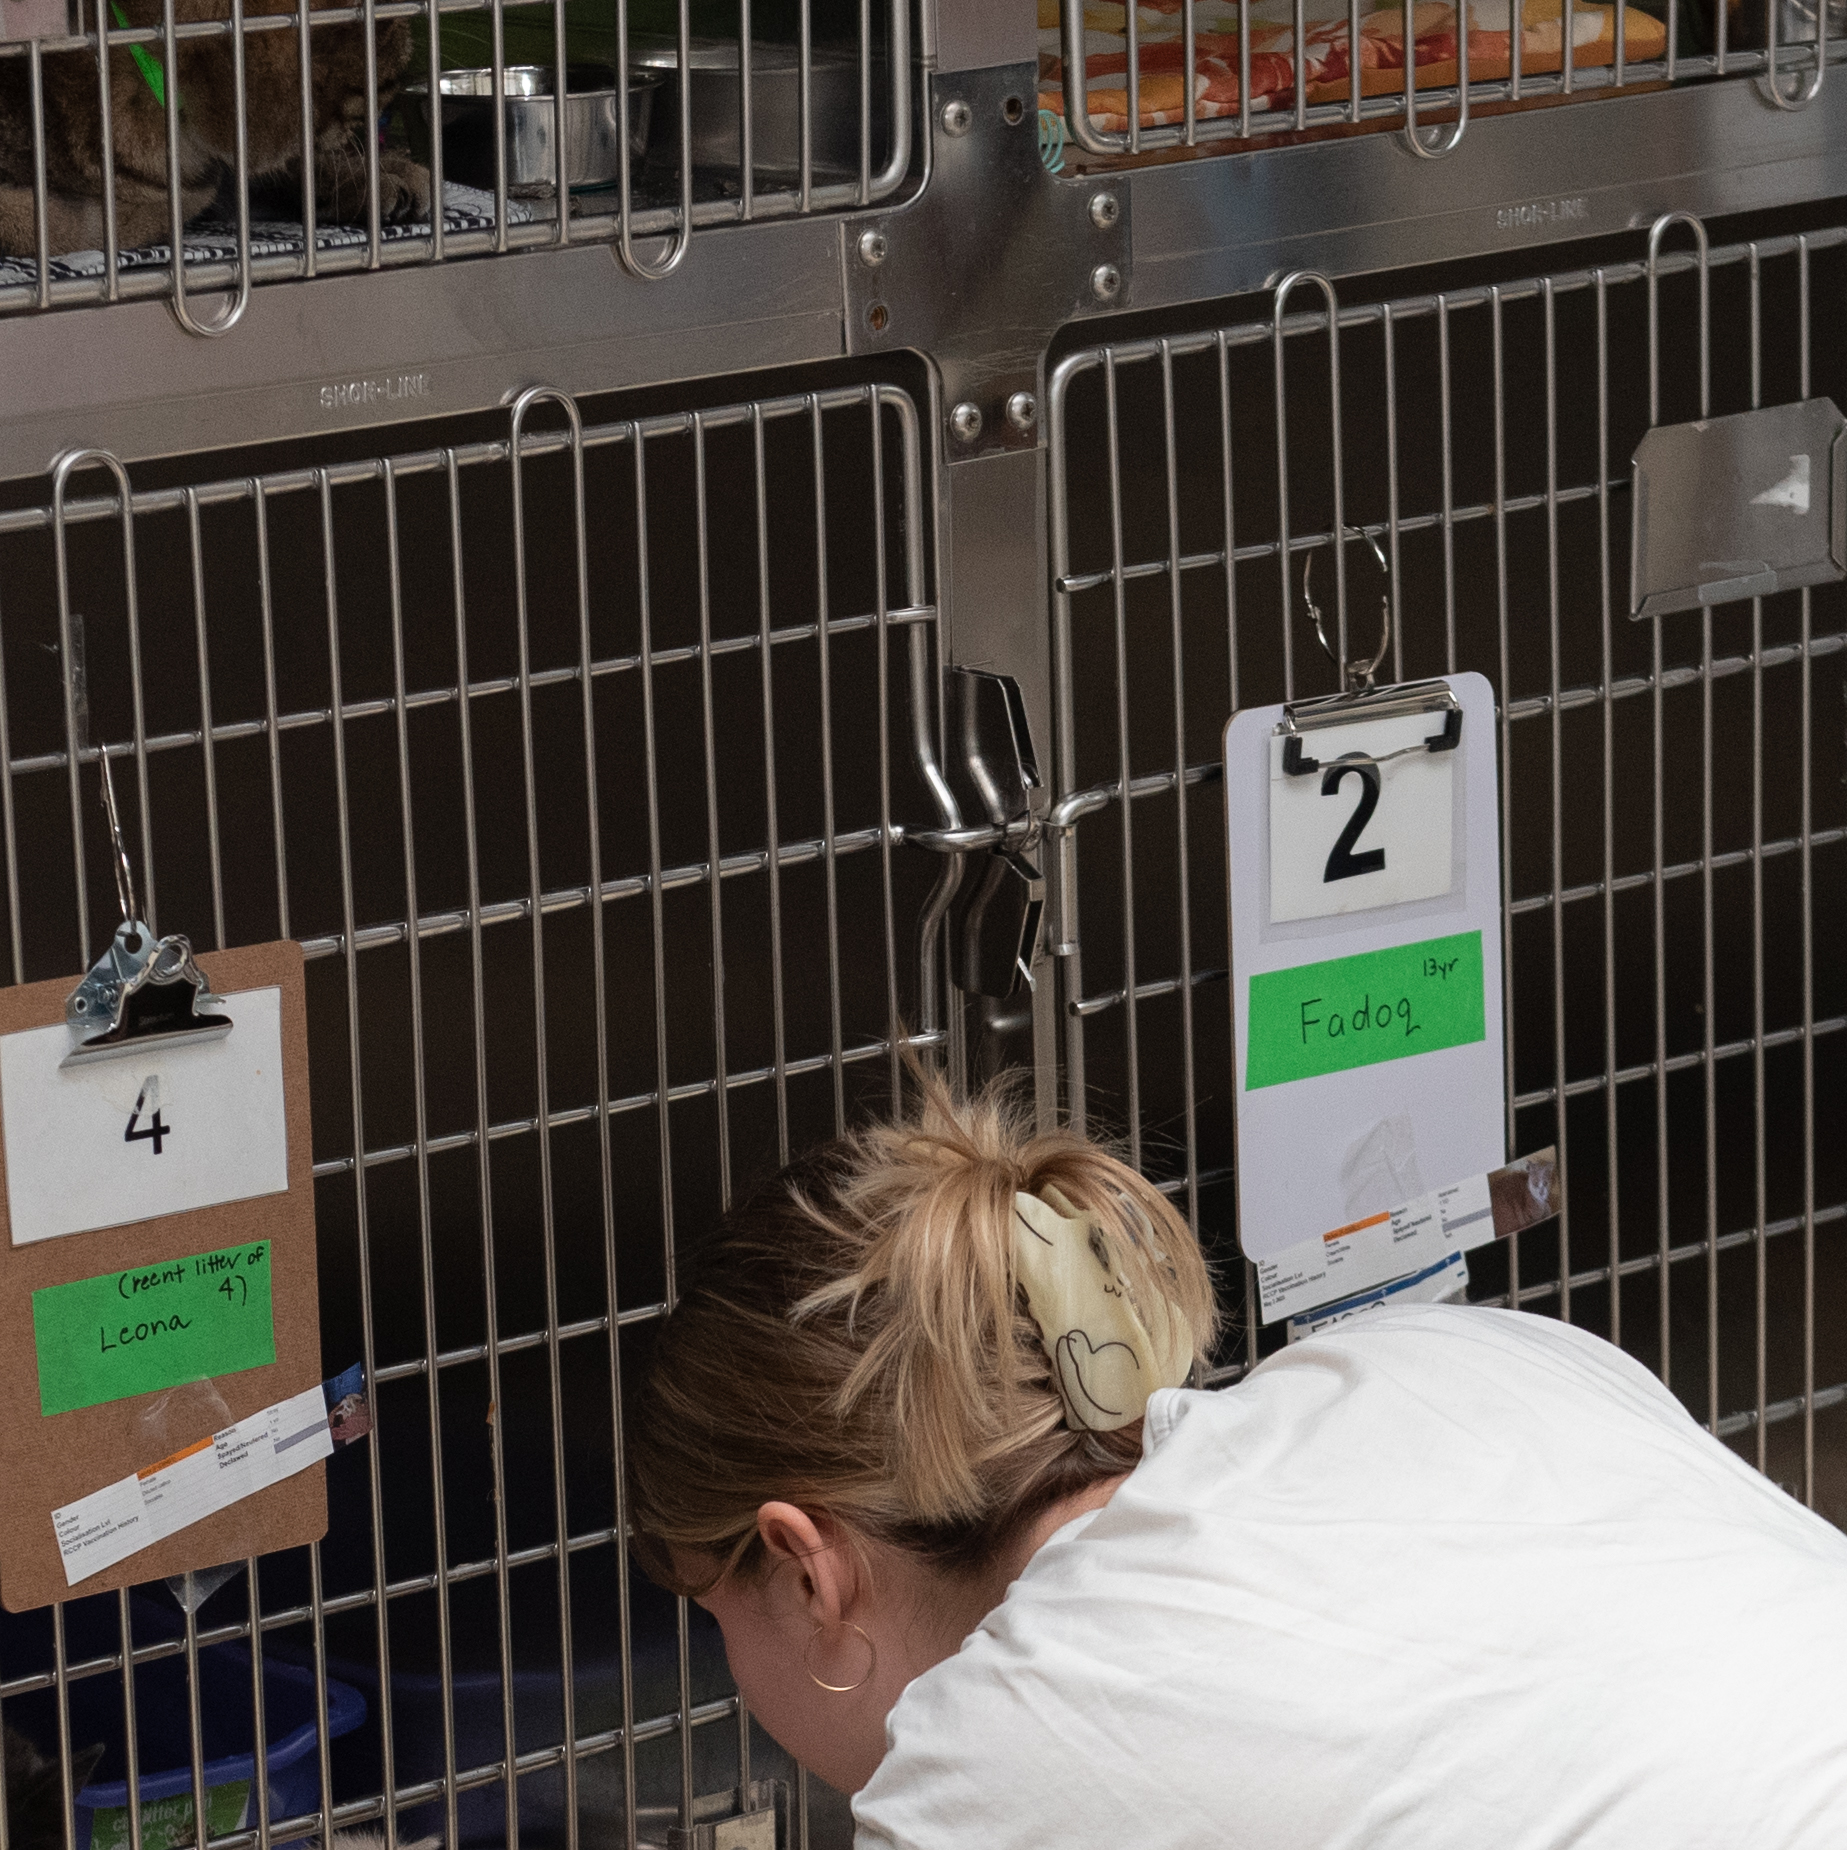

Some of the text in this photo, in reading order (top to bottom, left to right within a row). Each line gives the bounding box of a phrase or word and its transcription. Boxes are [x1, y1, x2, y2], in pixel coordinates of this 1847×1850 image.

[320, 374, 431, 409] SHOR-LINE
[1321, 751, 1385, 883] 2
[1423, 957, 1459, 980] 13yr
[1301, 993, 1421, 1044] Fadoq
[124, 1074, 170, 1155] 4
[195, 1253, 242, 1276] litter
[248, 1246, 265, 1265] of
[218, 1274, 247, 1307] 4)
[101, 1314, 193, 1353] Leona
[213, 1428, 237, 1441] Reason
[215, 1442, 228, 1451] Age
[219, 1451, 249, 1469] Declawed
[56, 1514, 79, 1529] Gender
[58, 1524, 80, 1538] Colour
[63, 1543, 82, 1556] RCCP
[117, 1515, 139, 1530] History
